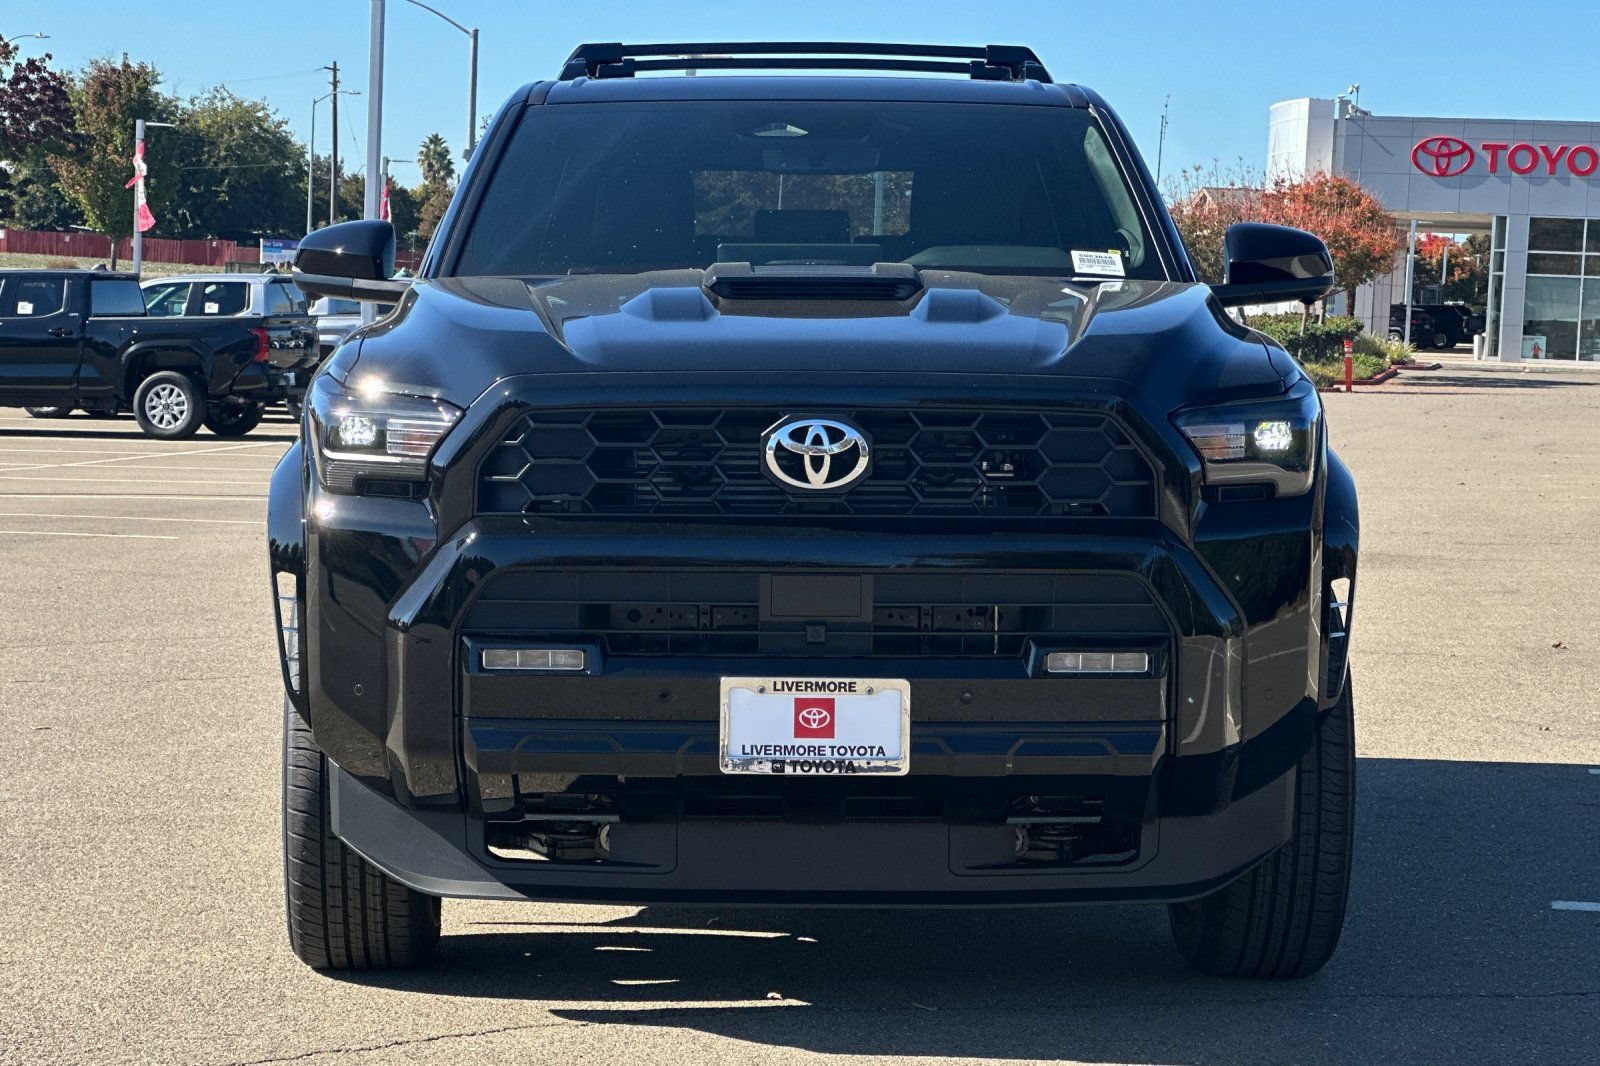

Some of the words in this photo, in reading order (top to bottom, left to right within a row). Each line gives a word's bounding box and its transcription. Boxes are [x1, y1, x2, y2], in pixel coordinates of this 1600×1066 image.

[1481, 143, 1600, 177] TOYO
[773, 681, 857, 693] LIVERMORE
[742, 744, 826, 756] LIVERMORE
[829, 745, 886, 757] TOYOTA
[792, 760, 857, 773] TOYOTA
